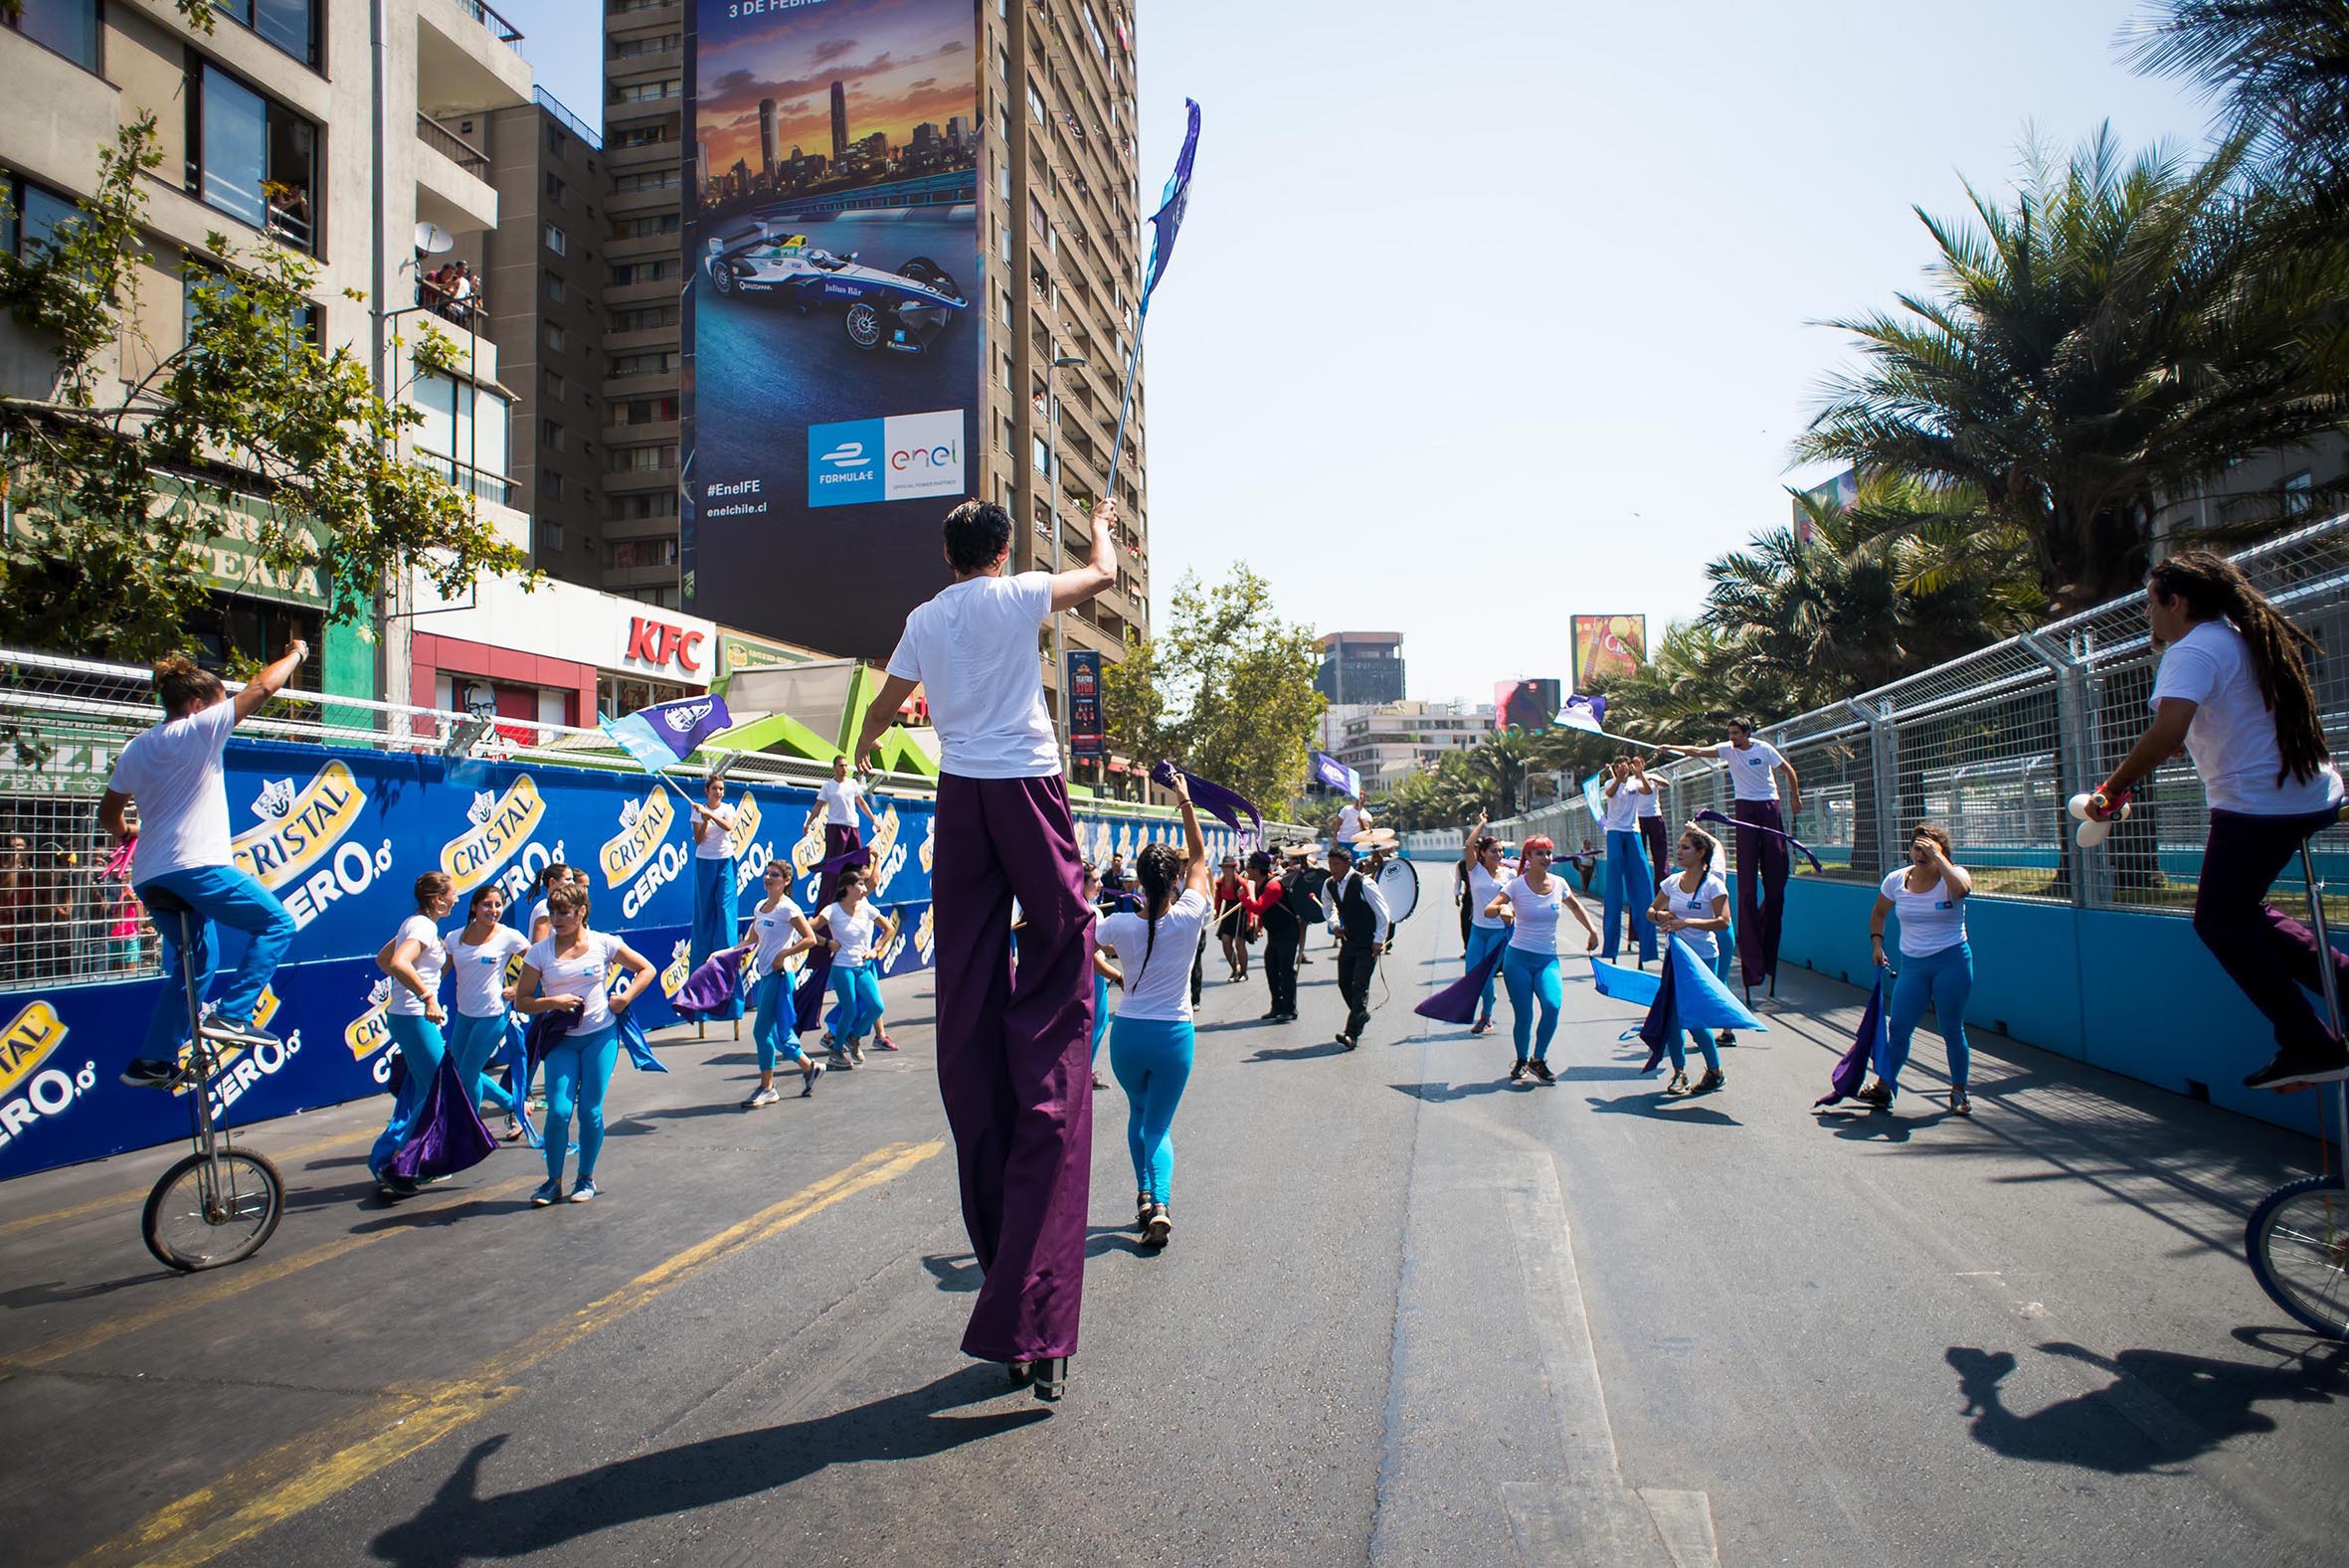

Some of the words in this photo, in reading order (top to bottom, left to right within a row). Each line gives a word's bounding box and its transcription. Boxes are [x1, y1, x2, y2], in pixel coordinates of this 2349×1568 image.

[729, 4, 738, 18] 3
[743, 0, 765, 15] DE
[891, 439, 958, 471] enel
[707, 479, 761, 497] #EnelFE
[707, 502, 768, 518] enelchile.cl
[626, 616, 705, 672] KFC
[452, 795, 534, 876] CRISTAL
[609, 803, 666, 873] CRISTAL
